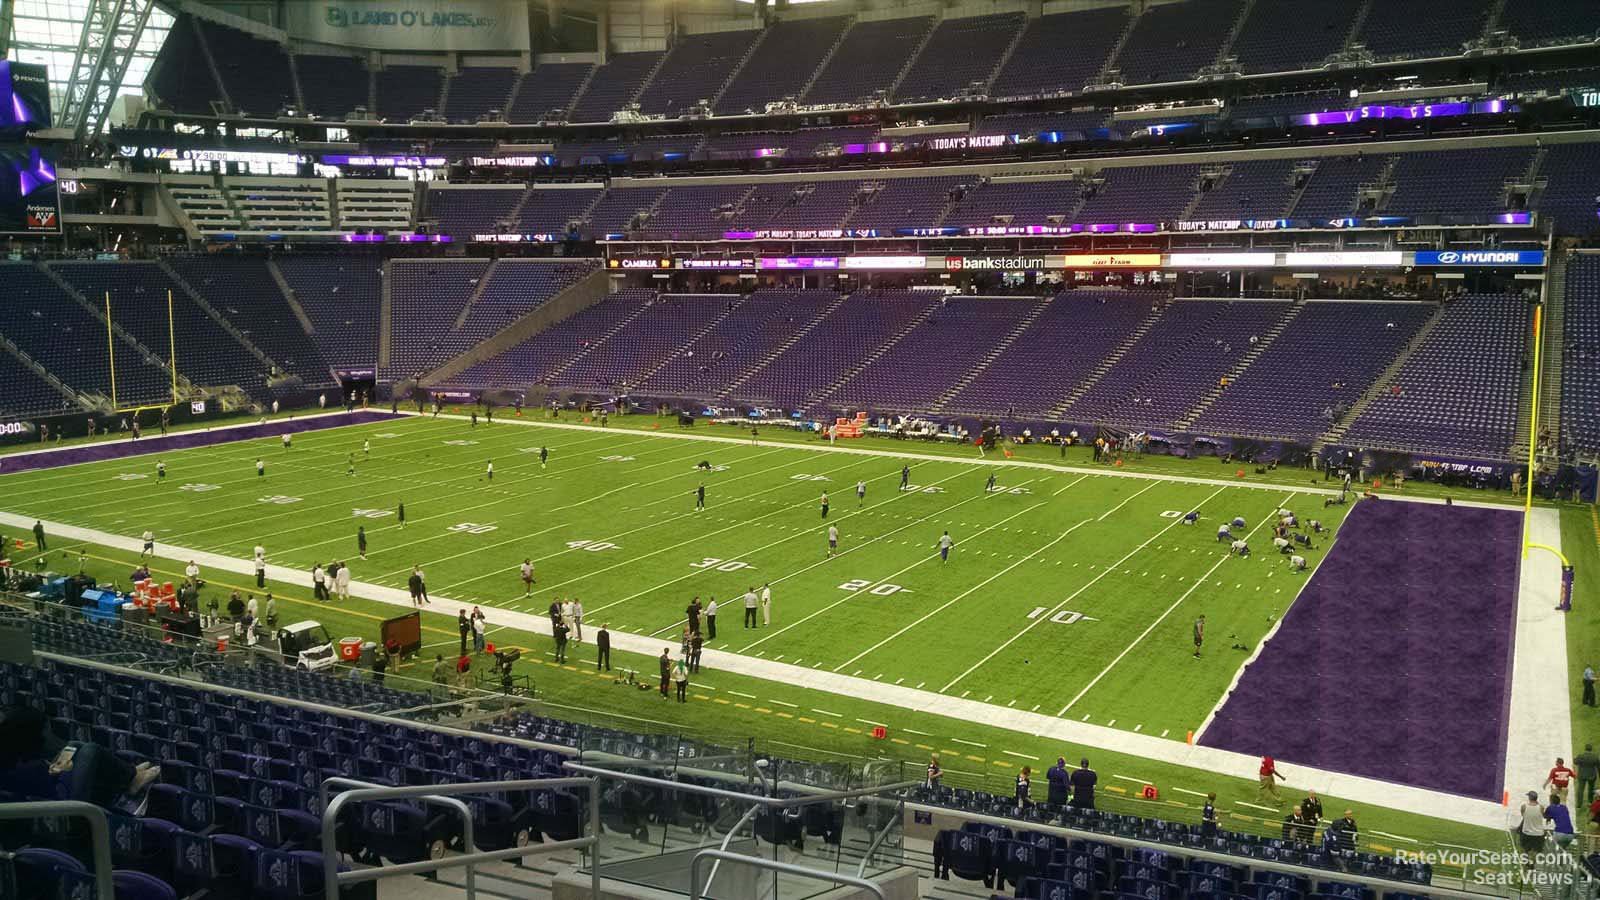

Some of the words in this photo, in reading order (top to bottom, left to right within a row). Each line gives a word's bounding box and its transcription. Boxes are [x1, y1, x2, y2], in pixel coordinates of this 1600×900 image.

[352, 11, 398, 25] LAND
[935, 137, 966, 150] TODAY'S
[969, 135, 1006, 148] MATCHUP
[61, 182, 77, 193] 40
[1178, 220, 1206, 230] TODAY'S
[1208, 220, 1241, 230] MATCHUP
[622, 259, 657, 268] CAMBRIA
[1462, 253, 1519, 262] HYUNDAI
[446, 522, 498, 534] 50
[565, 539, 617, 552] 40
[688, 557, 749, 572] 30
[837, 579, 903, 596] 20
[1026, 606, 1084, 625] 10
[343, 646, 353, 656] G
